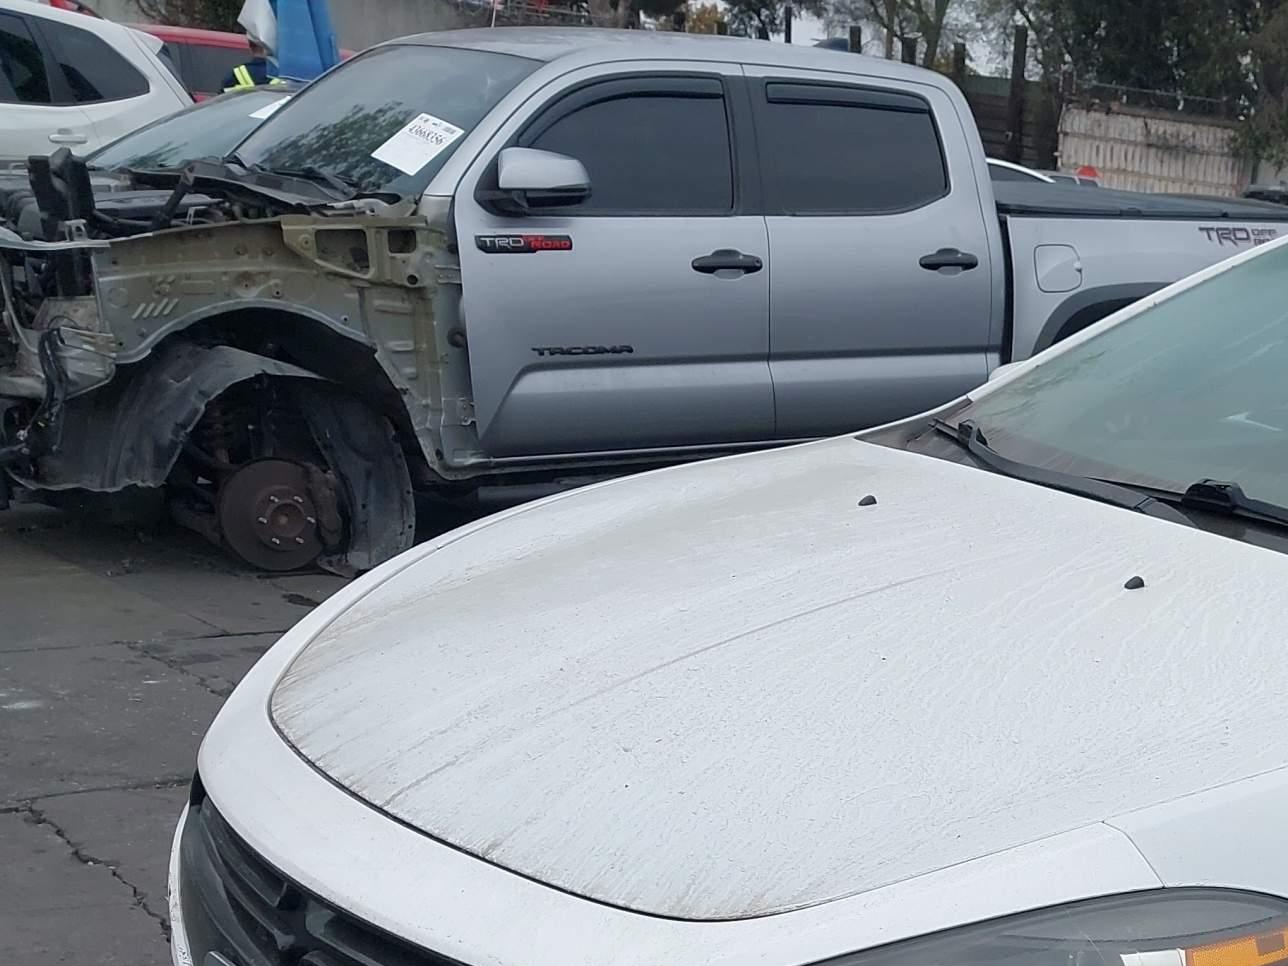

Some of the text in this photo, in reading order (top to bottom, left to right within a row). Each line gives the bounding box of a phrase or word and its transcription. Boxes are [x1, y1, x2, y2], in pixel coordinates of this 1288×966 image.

[479, 236, 525, 249] TRD
[1197, 226, 1251, 247] TRD
[530, 344, 634, 357] TACOMA
